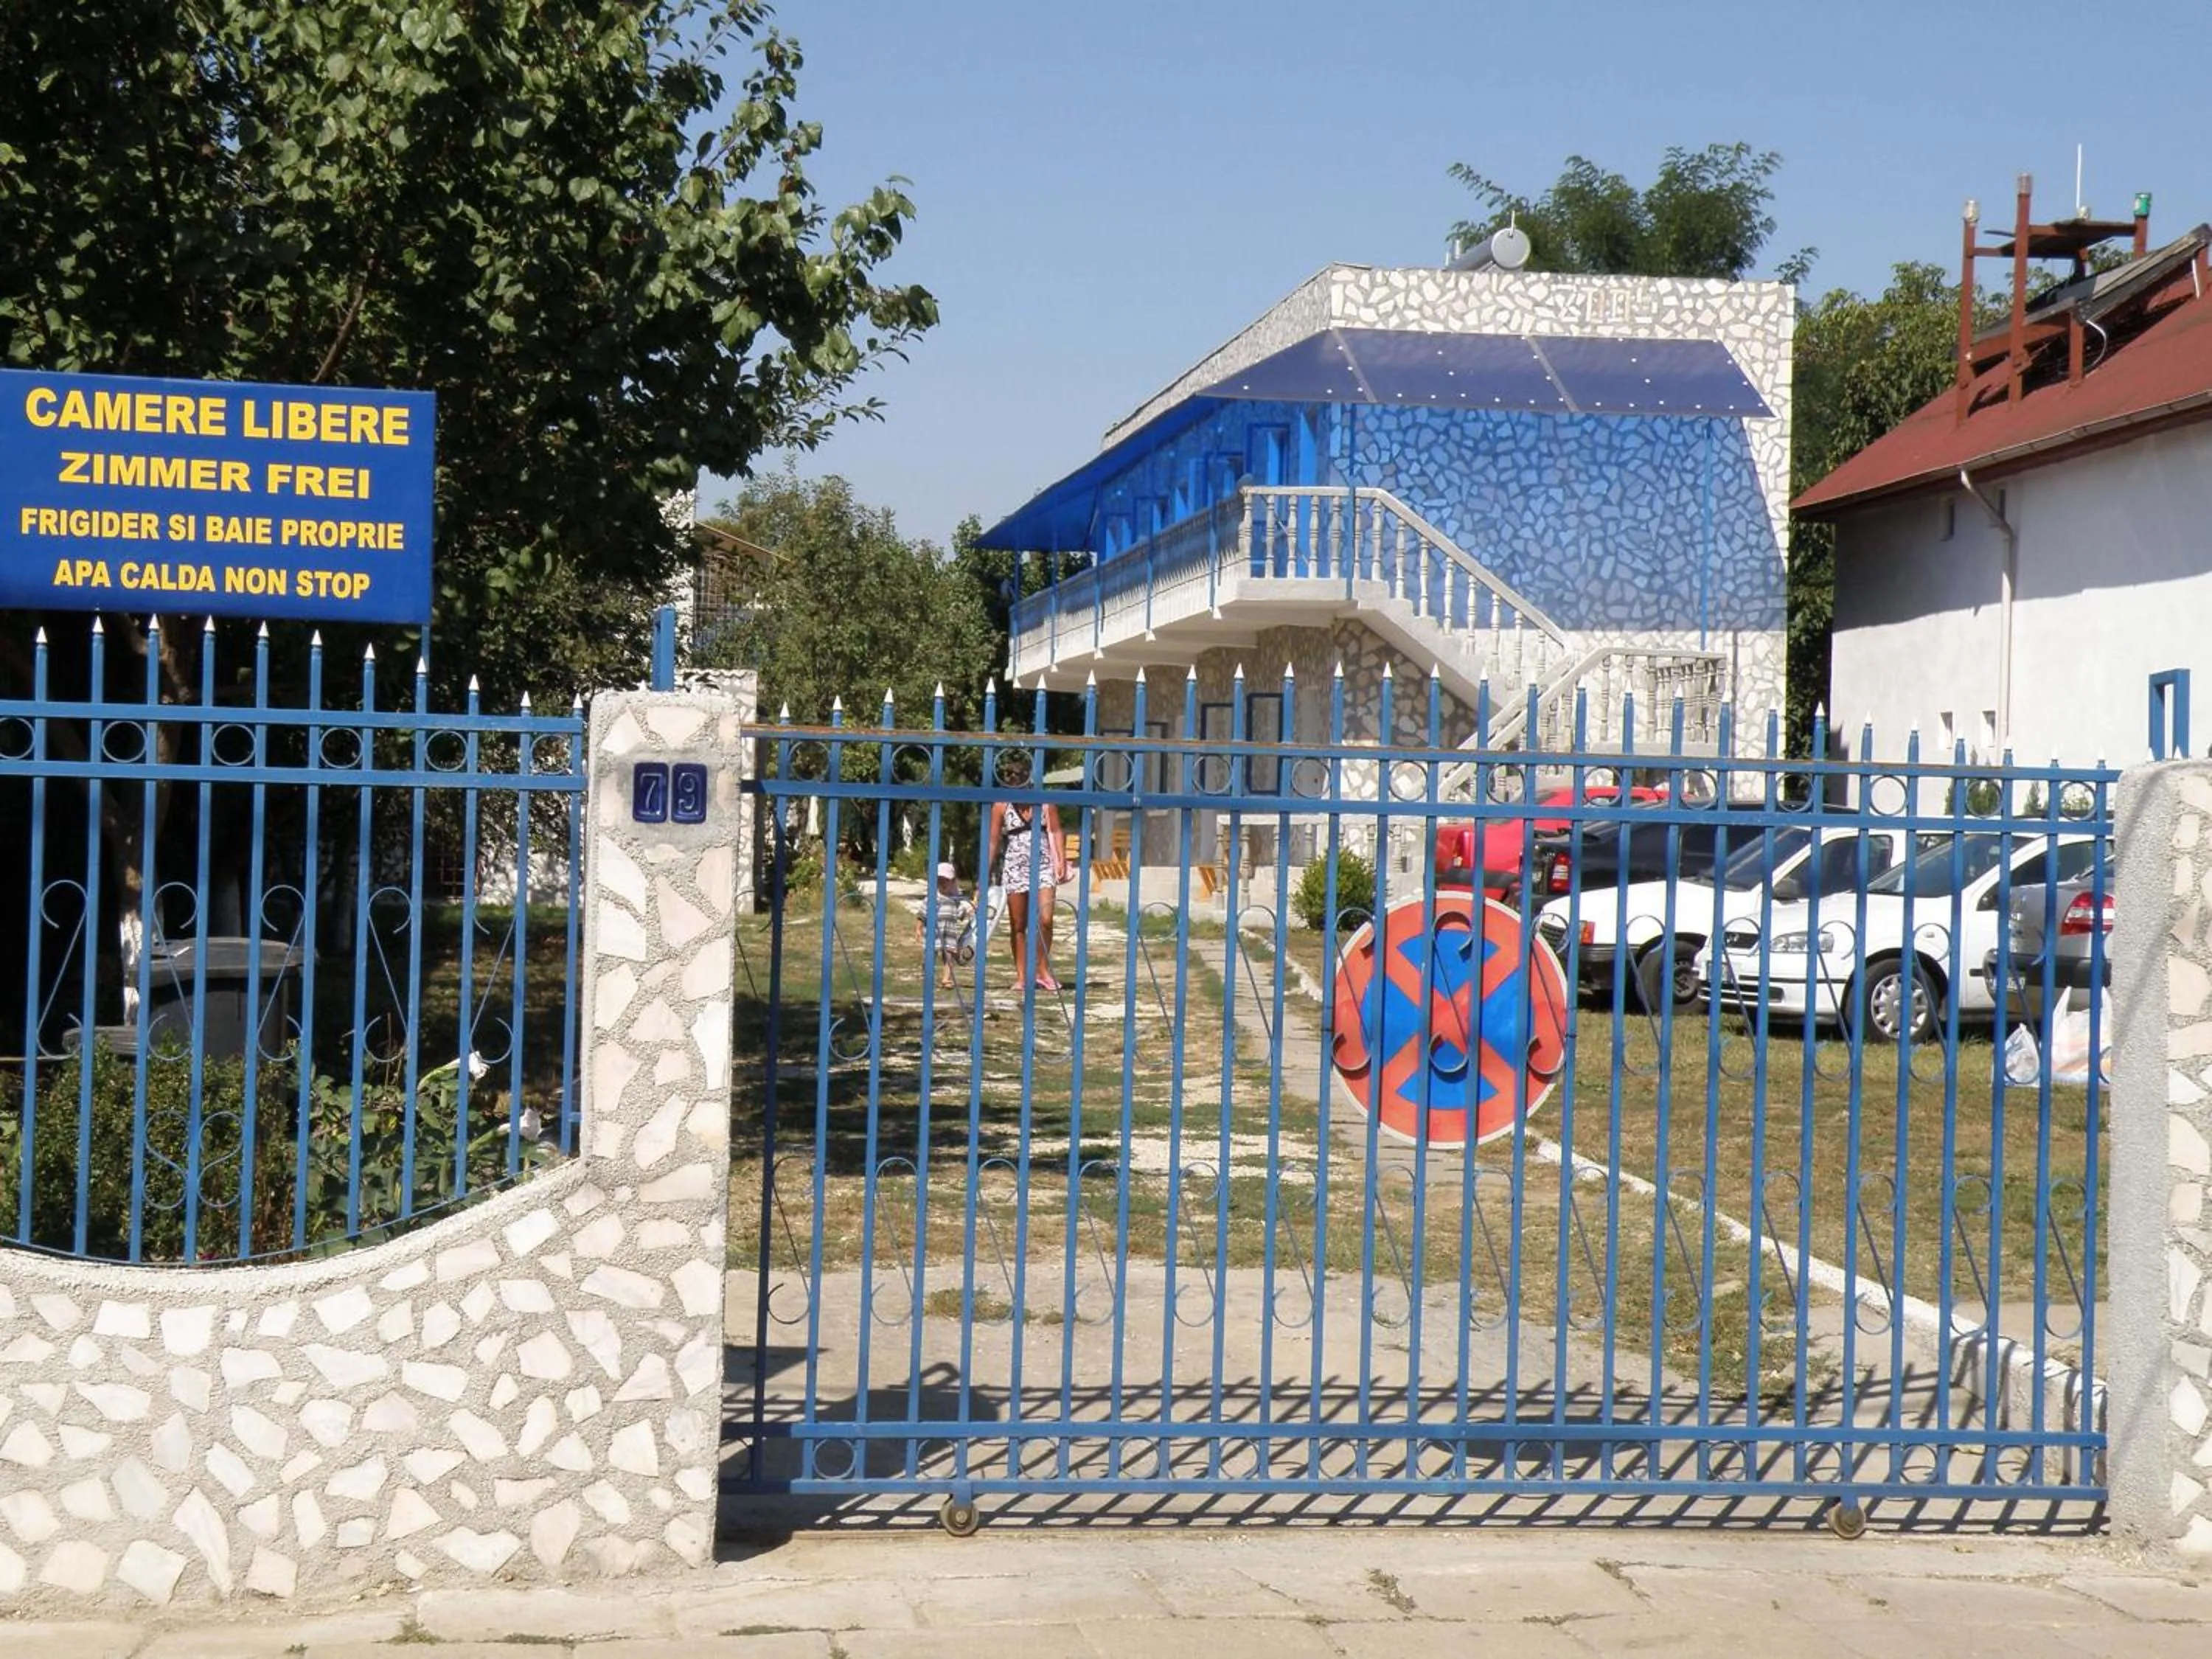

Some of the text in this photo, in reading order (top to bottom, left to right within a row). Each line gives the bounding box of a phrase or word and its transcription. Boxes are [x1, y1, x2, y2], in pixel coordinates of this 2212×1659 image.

[25, 387, 410, 446] CAMERE LIBERE
[58, 451, 370, 499] ZIMMER FREI
[21, 507, 404, 550] FRIGIDER SI BAIE PROPRIE
[53, 559, 371, 599] APA CALDA NON STOP
[639, 771, 702, 815] 79
